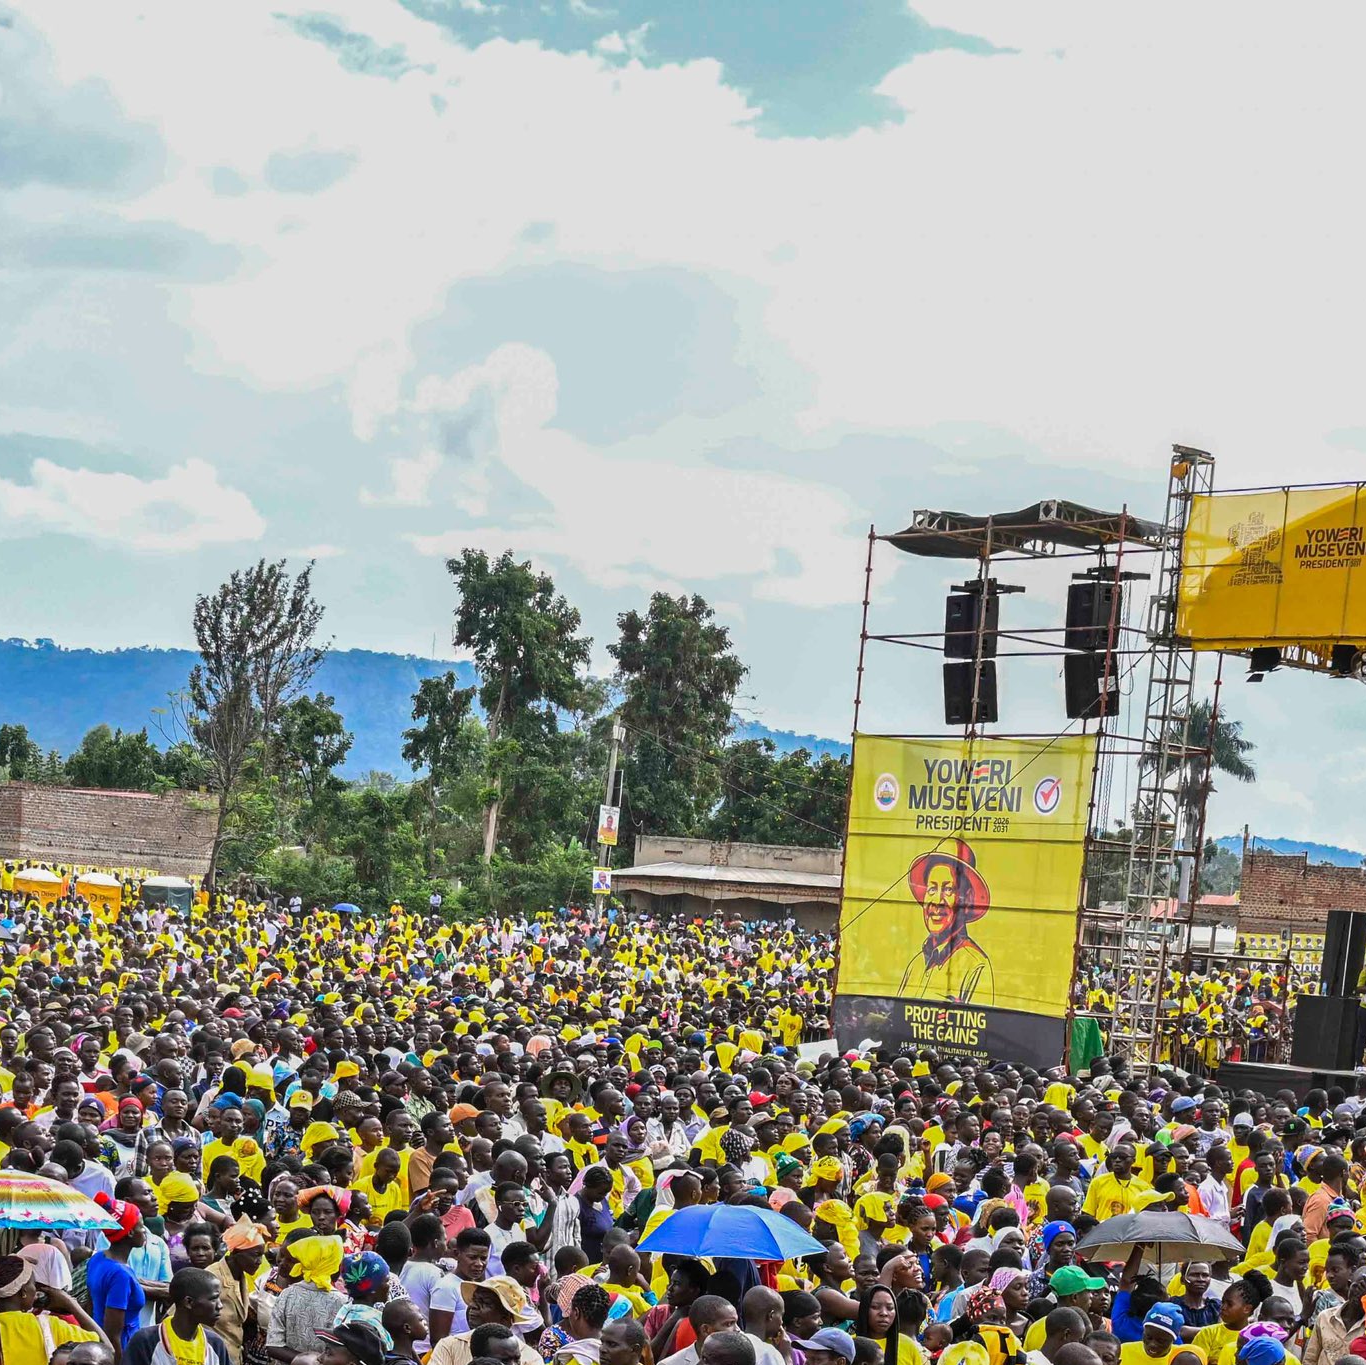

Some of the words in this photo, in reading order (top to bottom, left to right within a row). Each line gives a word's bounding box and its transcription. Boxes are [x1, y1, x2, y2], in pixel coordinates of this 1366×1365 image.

[1306, 527, 1363, 544] YOWERI
[1299, 558, 1350, 569] PRESIDENT
[923, 759, 1012, 784] YOWERI
[908, 784, 1022, 812] MUSEVENI
[916, 815, 991, 831] PRESIDENT
[904, 1005, 986, 1029] PROTECTING
[910, 1023, 934, 1040] THE
[936, 1026, 979, 1045] GAINS
